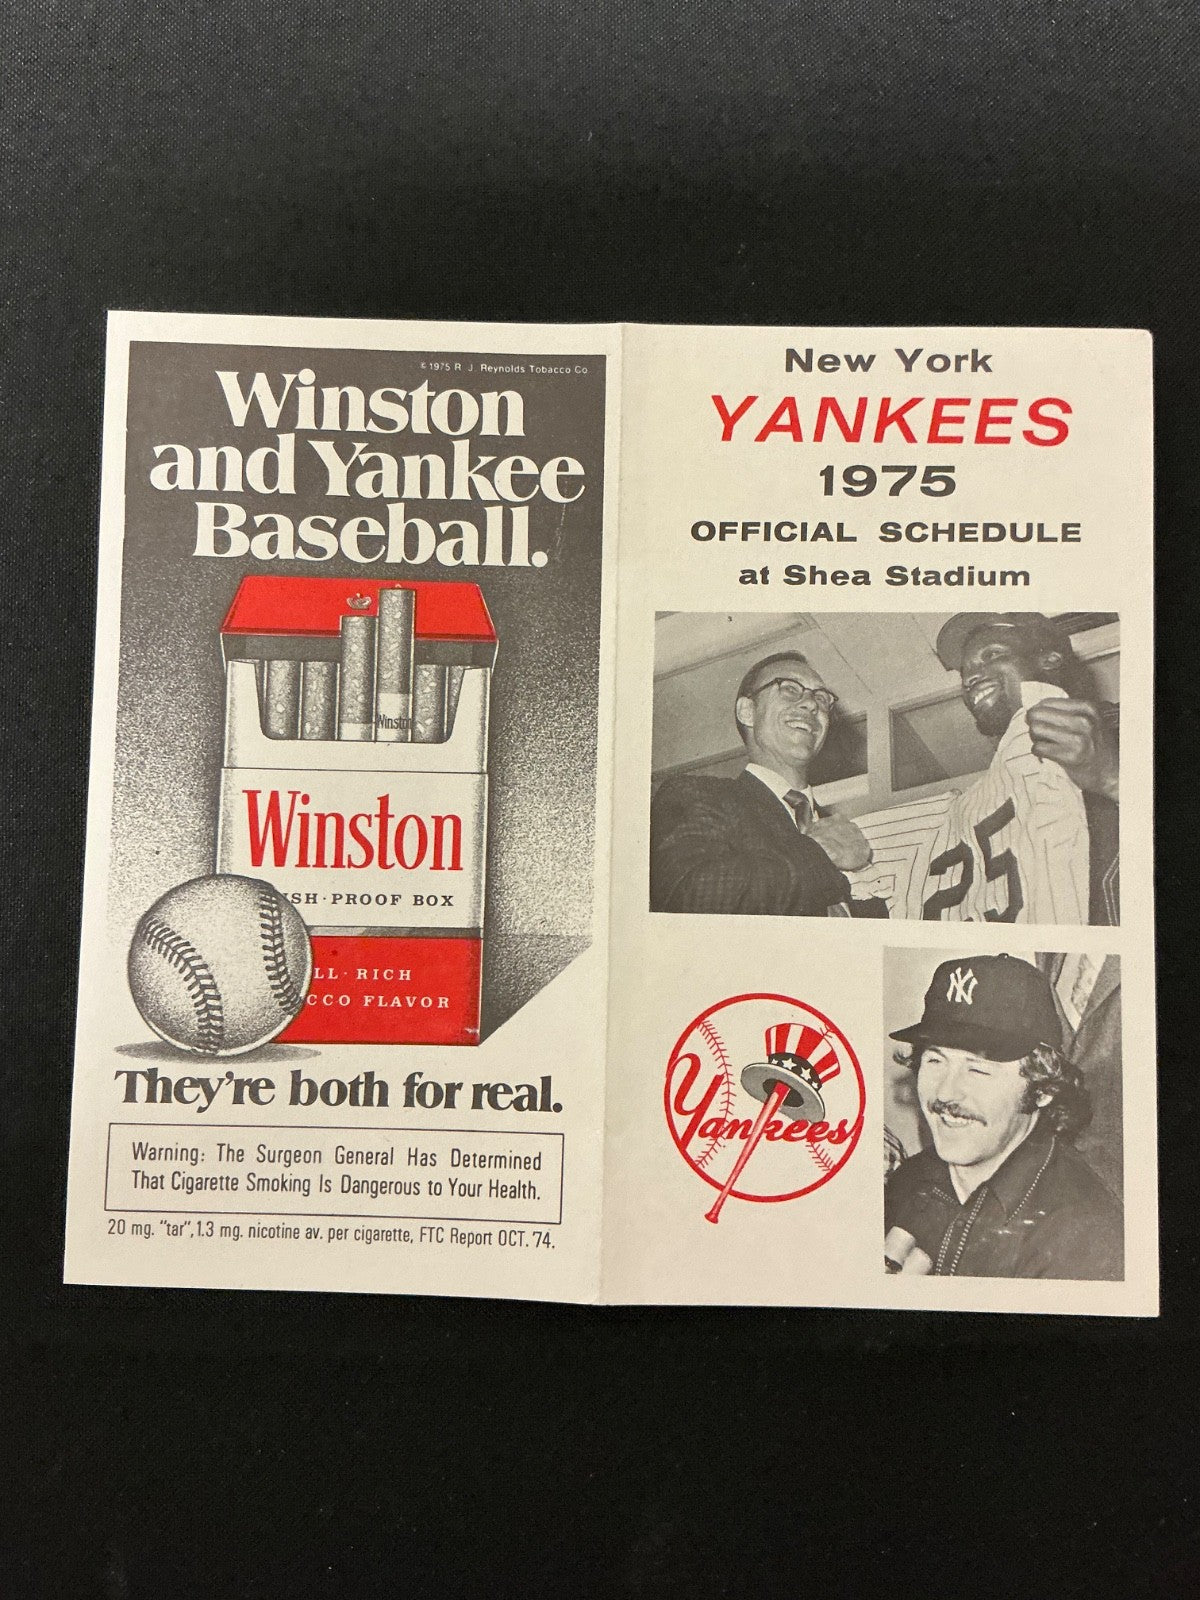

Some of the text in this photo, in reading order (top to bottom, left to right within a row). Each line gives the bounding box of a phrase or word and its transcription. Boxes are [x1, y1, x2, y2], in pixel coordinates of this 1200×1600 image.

[429, 363, 450, 371] 1975
[480, 364, 526, 375] Reynolds
[529, 365, 571, 374] Tobacco
[575, 366, 588, 374] Co
[785, 348, 993, 373] New York
[215, 368, 525, 437] Winston
[710, 395, 1073, 447] YANKEES
[150, 433, 585, 502] and Yankee
[819, 465, 956, 497] 1975
[193, 502, 548, 567] Baseball.
[691, 520, 1081, 543] OFFICIAL SCHEDULE
[738, 565, 1030, 586] at Shea Stadium
[242, 790, 464, 871] Winston
[413, 895, 454, 907] BOX
[364, 996, 450, 1008] FLAVOR
[289, 1070, 389, 1107] both
[403, 1072, 463, 1109] for
[471, 1075, 563, 1113] real.
[665, 1053, 864, 1150] Yankees
[132, 1142, 542, 1170] Warning: The Surgeon General Has Determined
[132, 1170, 540, 1200] That Cigarette Smoking Is Dangerous to Your Health.
[108, 1219, 125, 1235] 20
[131, 1224, 154, 1239] mg.
[220, 1226, 243, 1241] mg.
[248, 1222, 299, 1239] nicotine
[305, 1227, 323, 1240] av.
[328, 1228, 349, 1243] per
[354, 1225, 413, 1244] cigarette,
[420, 1227, 444, 1243] FTC
[451, 1228, 492, 1248] Report
[499, 1230, 528, 1247] OCT.
